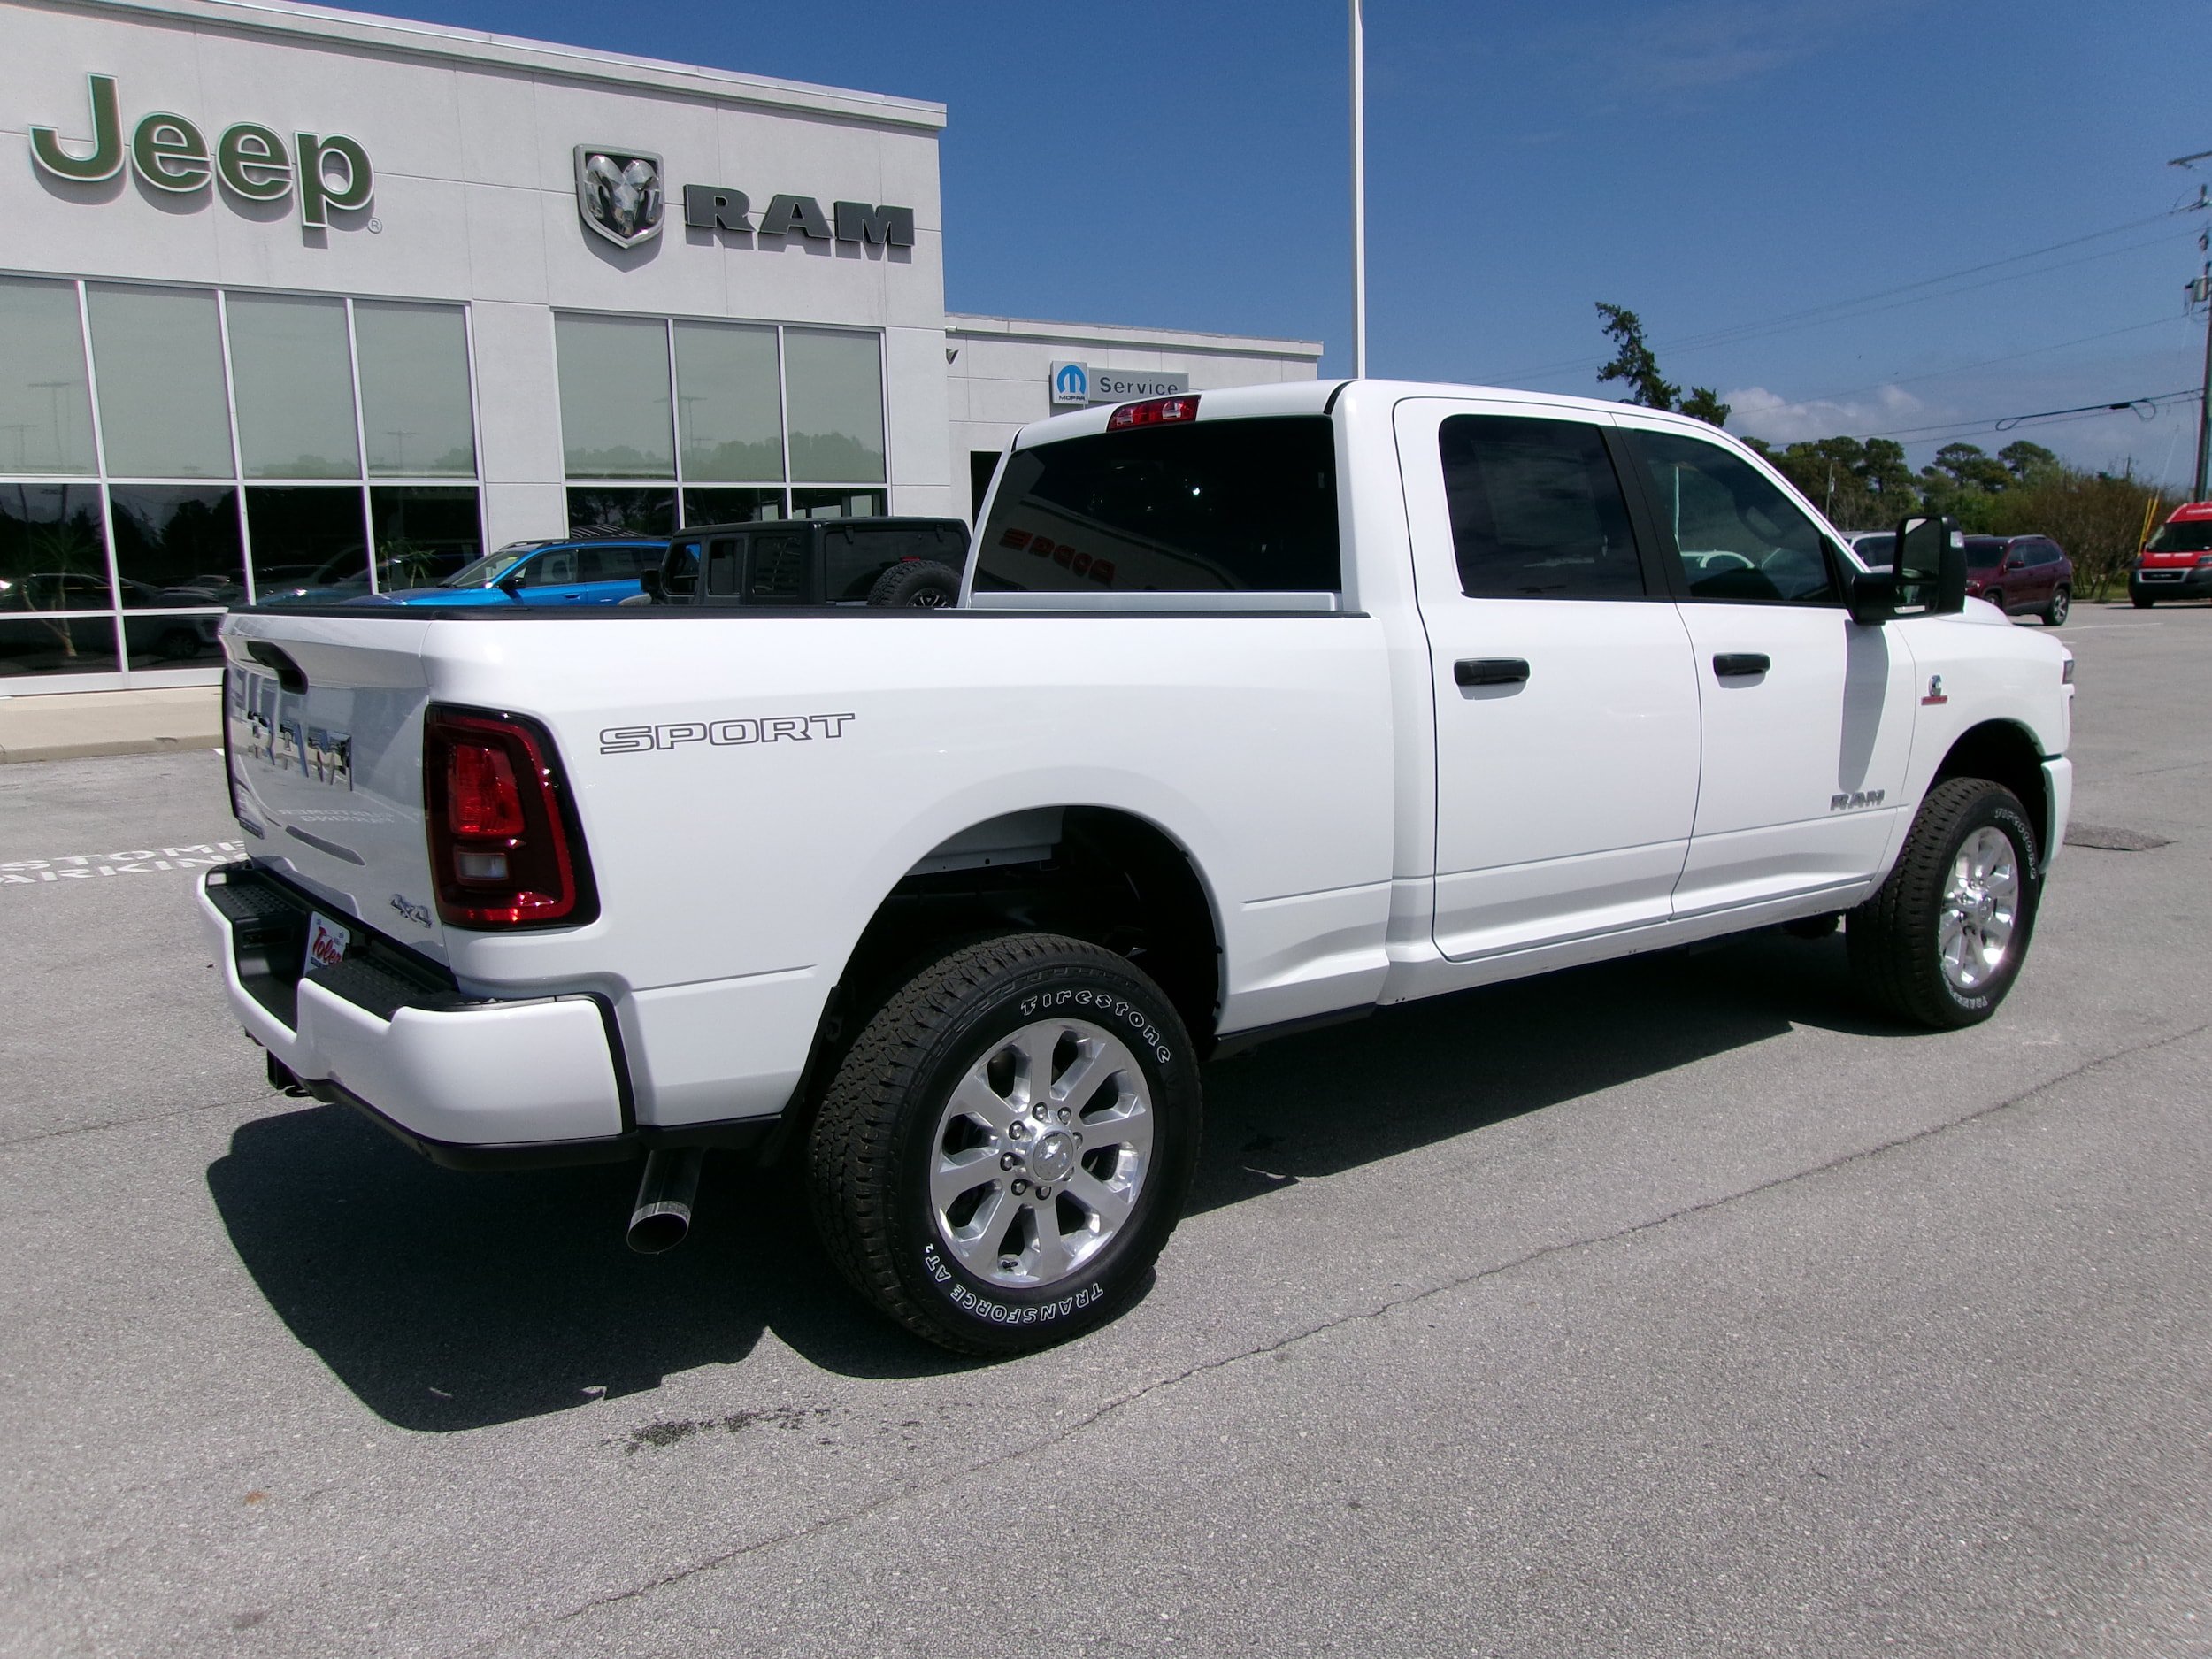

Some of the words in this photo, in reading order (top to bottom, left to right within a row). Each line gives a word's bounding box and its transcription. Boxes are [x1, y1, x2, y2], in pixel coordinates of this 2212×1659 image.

[28, 72, 376, 229] Jeep
[683, 184, 916, 248] RAM
[1099, 376, 1179, 396] Service
[599, 712, 856, 755] SPORT
[1830, 789, 1886, 811] RAM
[1020, 990, 1171, 1064] Firestone
[949, 1282, 1104, 1325] TRANSFORCE
